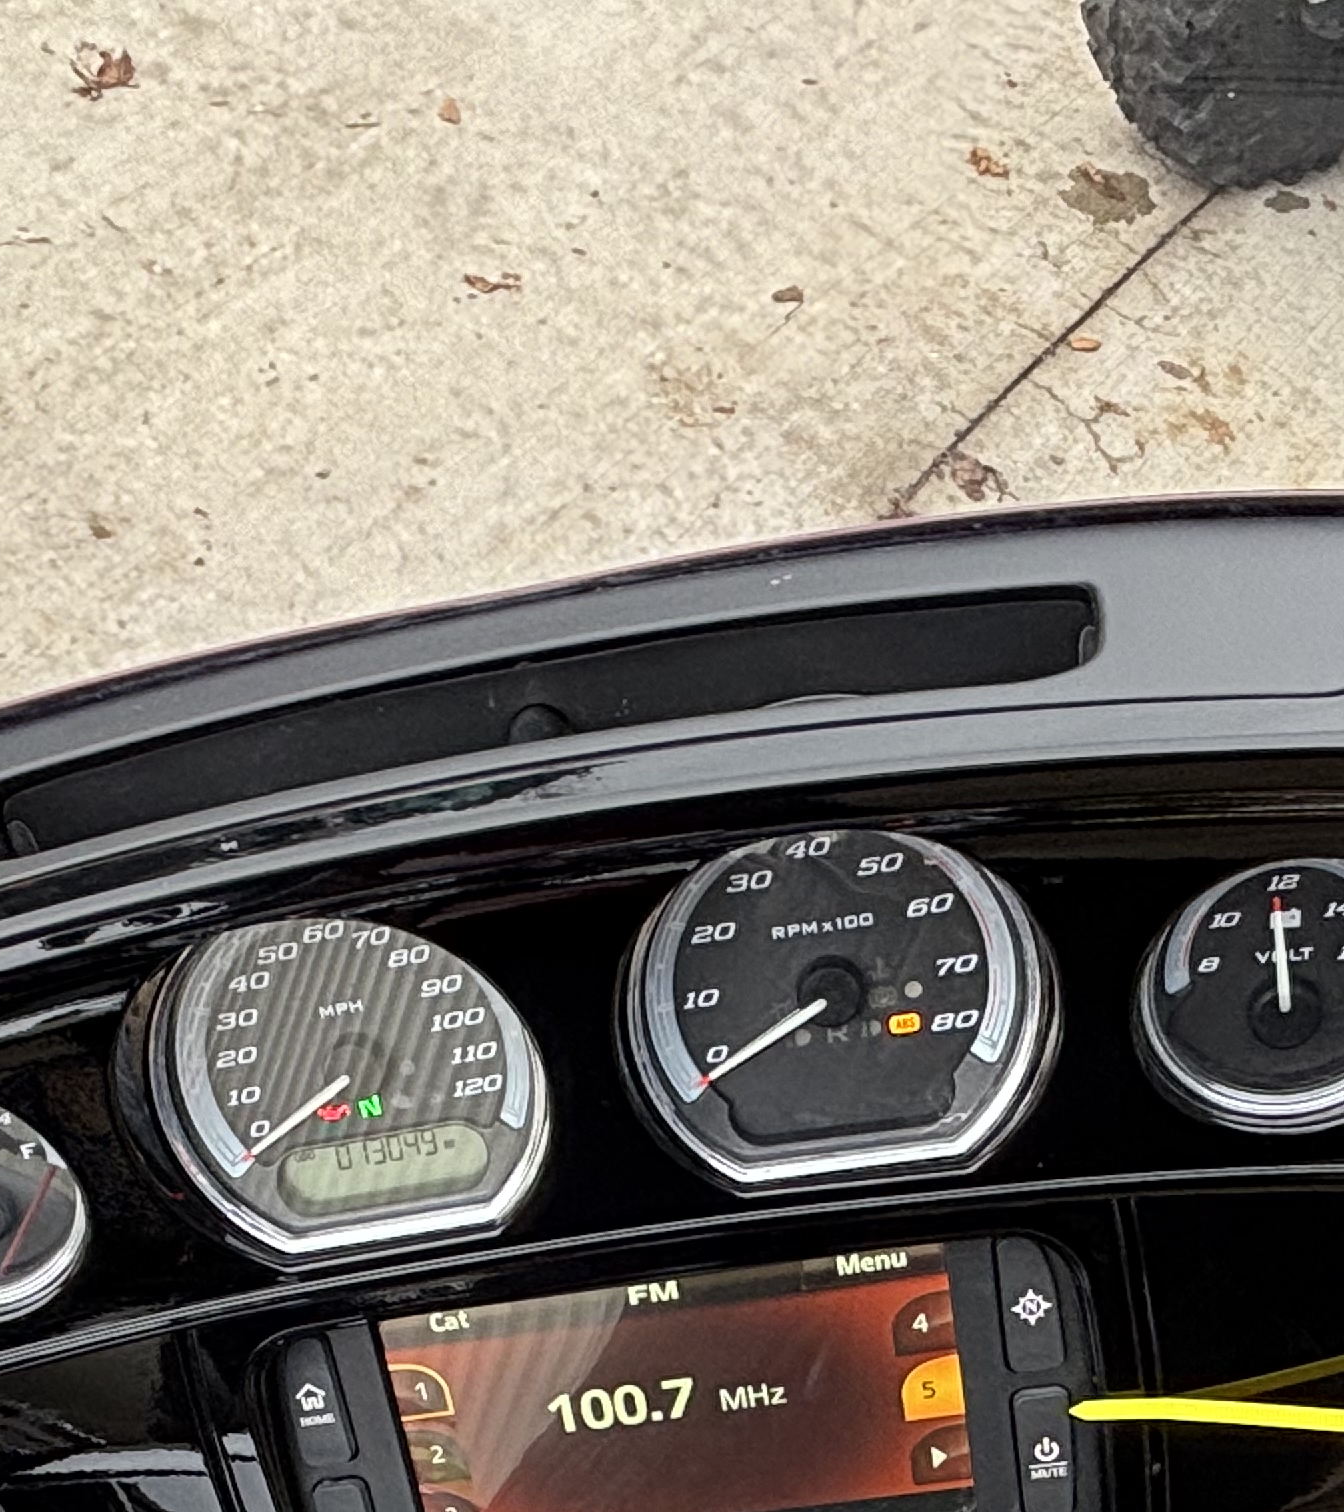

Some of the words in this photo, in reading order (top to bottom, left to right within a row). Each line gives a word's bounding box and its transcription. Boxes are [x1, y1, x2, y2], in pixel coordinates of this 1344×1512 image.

[784, 836, 832, 860] 40
[857, 852, 905, 877] 50
[725, 870, 773, 894] 30
[1267, 874, 1301, 891] 12
[906, 893, 954, 918] 60
[302, 920, 345, 943] 60
[771, 920, 818, 940] RPM
[1208, 912, 1242, 929] 10
[351, 926, 391, 949] 70
[690, 922, 736, 945] 20
[256, 942, 299, 965] 50
[387, 945, 430, 968] 80
[935, 953, 978, 977] 70
[1197, 957, 1221, 973] 8
[228, 971, 271, 994] 40
[420, 974, 463, 998] 90
[318, 999, 364, 1019] MPH
[682, 988, 720, 1010] 10
[216, 1008, 259, 1031] 30
[430, 1007, 486, 1033] 100
[896, 1016, 916, 1030] ABS
[930, 1010, 979, 1033] 80
[216, 1047, 258, 1069] 20
[450, 1041, 498, 1065] 110
[706, 1045, 729, 1063] 0
[227, 1086, 262, 1107] 10
[452, 1074, 504, 1098] 120
[357, 1093, 383, 1119] N
[250, 1120, 270, 1138] 0
[20, 1142, 36, 1160] F
[836, 1250, 908, 1277] Menu
[627, 1280, 680, 1306] FM
[428, 1311, 470, 1334] Cat
[912, 1313, 929, 1334] 4
[414, 1382, 429, 1402] 1
[921, 1380, 936, 1400] 5
[547, 1377, 694, 1434] 100.7
[718, 1383, 788, 1412] MHz
[299, 1413, 336, 1428] HOME
[431, 1446, 446, 1464] 2
[1030, 1466, 1068, 1481] MUTE
